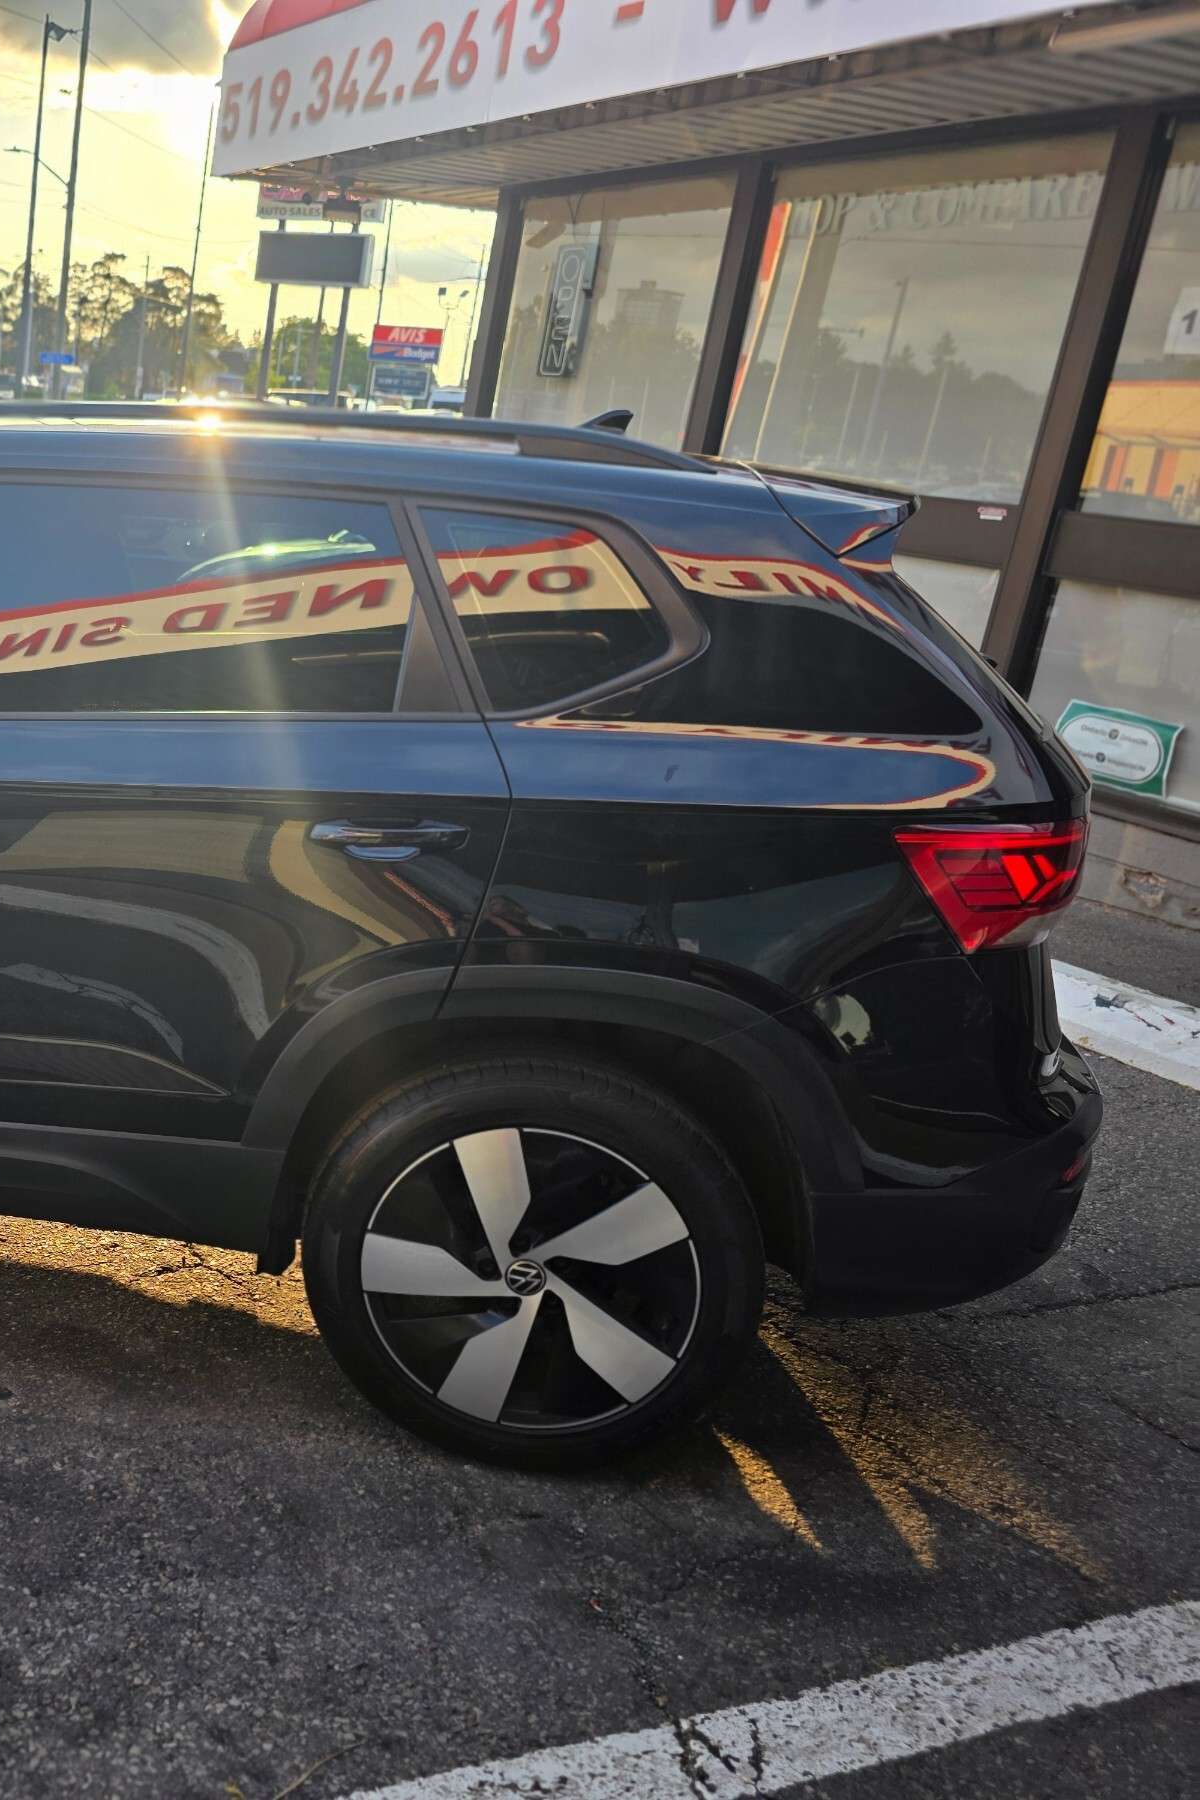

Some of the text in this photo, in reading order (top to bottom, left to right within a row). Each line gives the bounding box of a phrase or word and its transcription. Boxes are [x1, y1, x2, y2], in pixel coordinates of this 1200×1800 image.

[220, 0, 566, 142] 519.342.2613
[260, 206, 320, 217] AUTO SALES
[387, 327, 428, 343] AVIS
[403, 347, 435, 361] Budget
